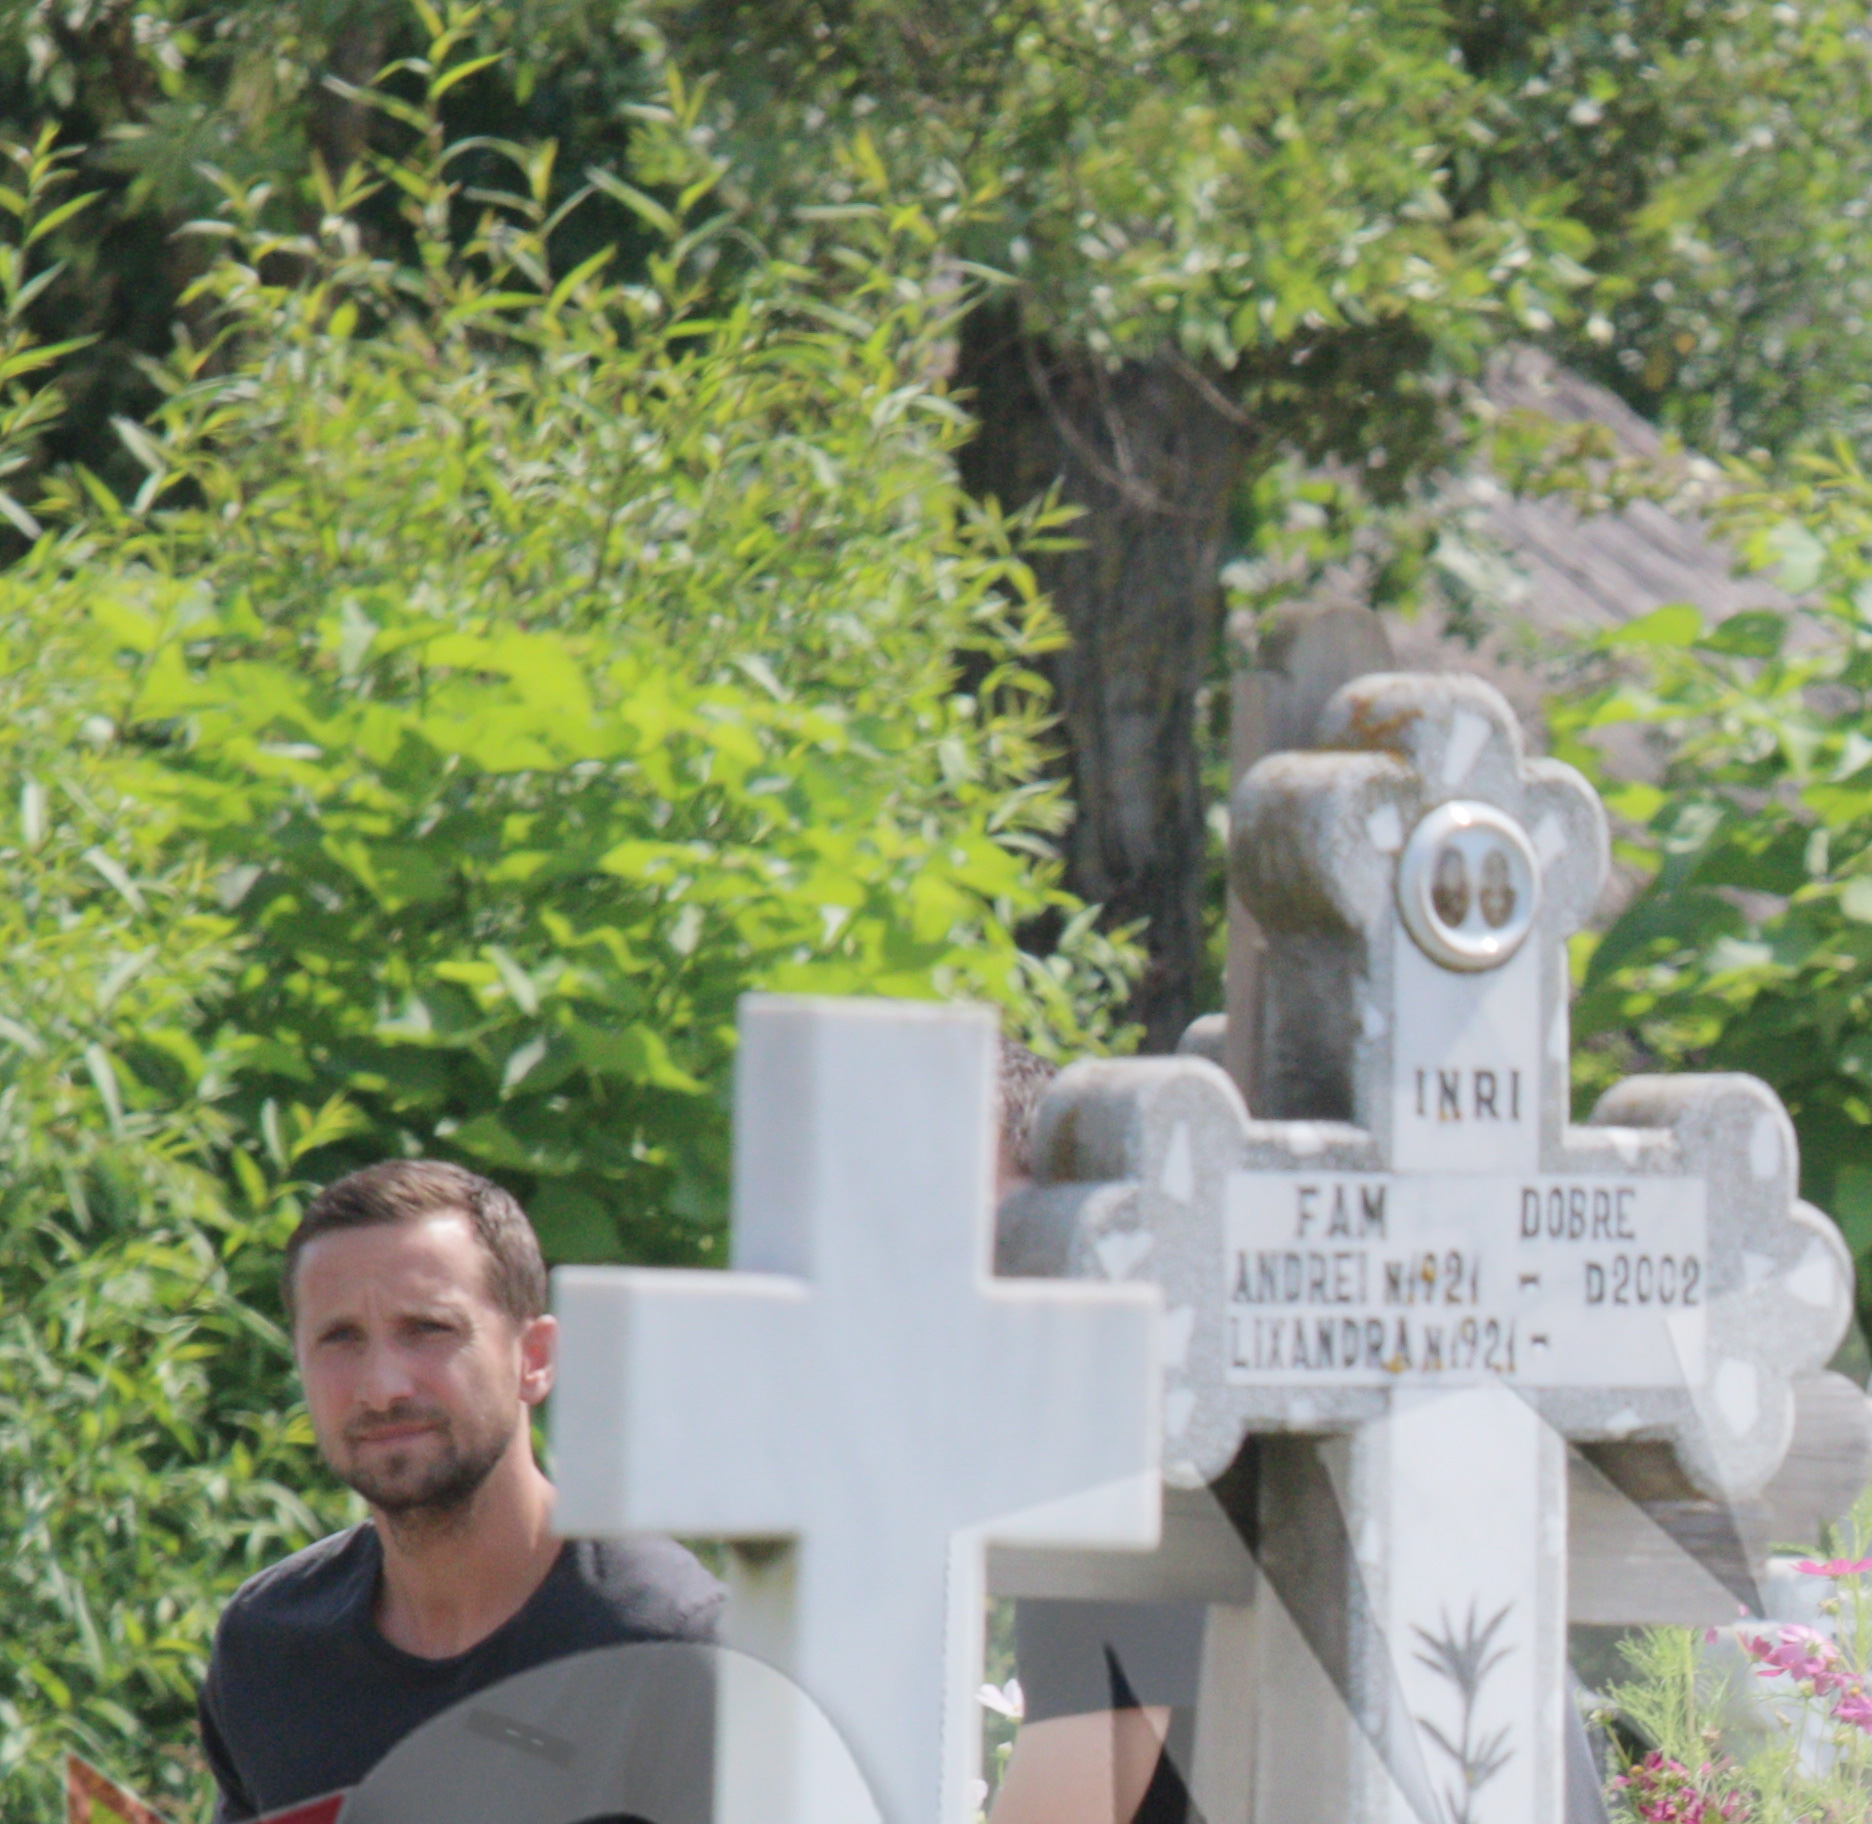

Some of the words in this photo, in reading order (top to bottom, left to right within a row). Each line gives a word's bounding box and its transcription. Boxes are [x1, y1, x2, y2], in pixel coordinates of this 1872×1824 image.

[1414, 1068, 1522, 1121] INRI
[1294, 1184, 1388, 1240] FAM
[1520, 1186, 1638, 1241] DOBRE
[1231, 1250, 1369, 1305] ANDREI
[1585, 1256, 1702, 1306] D2002
[1230, 1316, 1412, 1373] LIXANDRA
